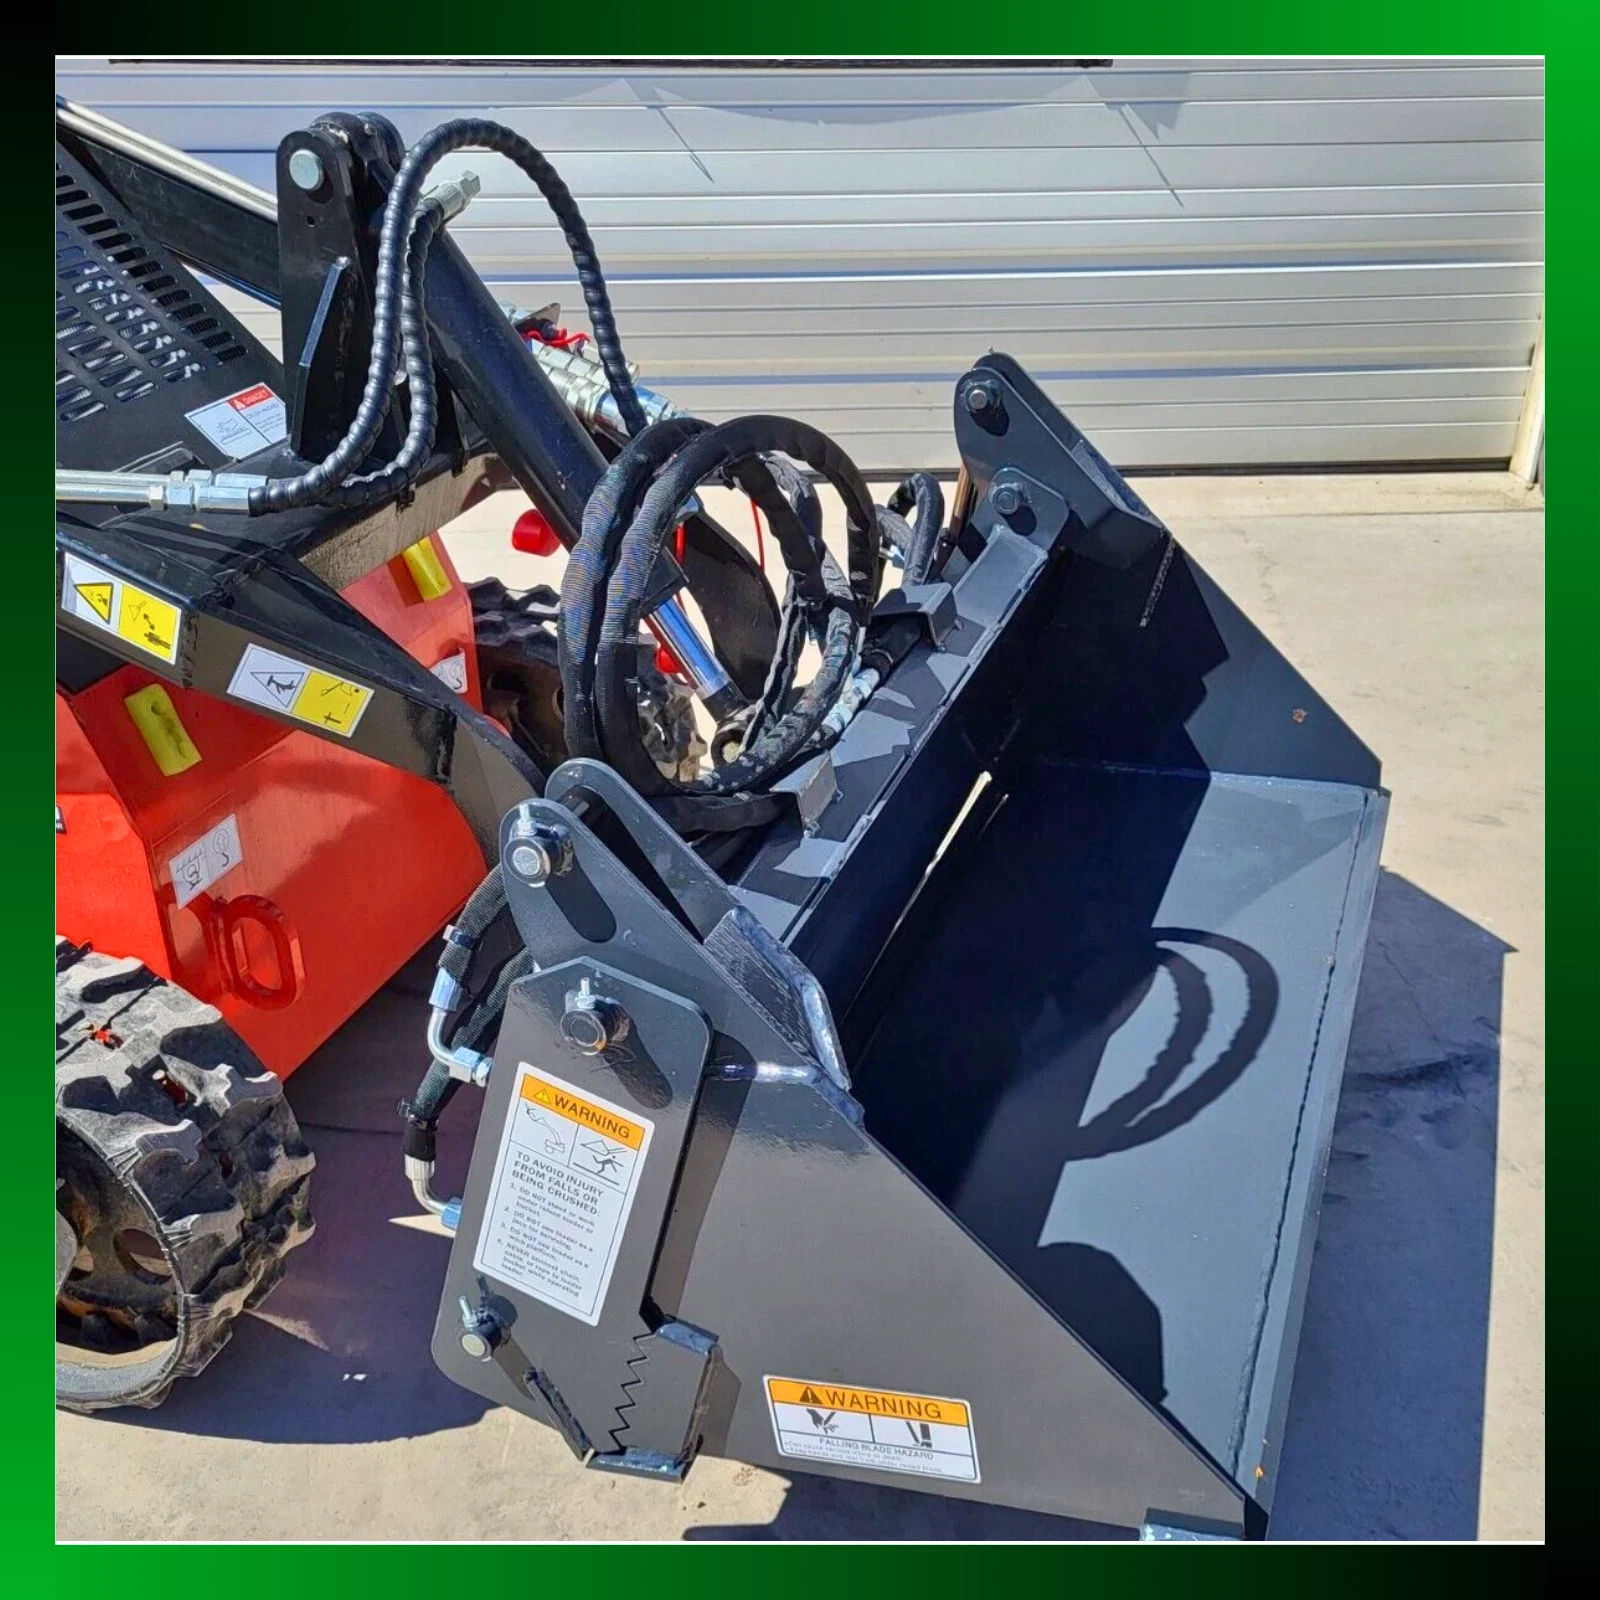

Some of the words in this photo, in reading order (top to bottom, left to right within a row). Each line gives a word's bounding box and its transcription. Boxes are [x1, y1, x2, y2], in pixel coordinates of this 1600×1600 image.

[554, 1094, 630, 1139] WARNING
[514, 1160, 546, 1180] FROM
[548, 1176, 579, 1197] FALLS
[582, 1191, 598, 1205] OR
[517, 1150, 530, 1162] TO
[532, 1158, 564, 1179] AVOID
[566, 1173, 604, 1197] INJURY
[511, 1169, 544, 1190] BEING
[547, 1187, 600, 1217] CRUSHED:
[519, 1186, 530, 1196] DO
[531, 1193, 546, 1203] NOT
[514, 1210, 525, 1219] DO
[526, 1216, 541, 1227] NOT
[507, 1243, 529, 1257] NEVER
[523, 1233, 537, 1243] NOT
[825, 1388, 941, 1419] WARNING
[820, 1438, 859, 1450] FALLING
[861, 1443, 892, 1455] BLADE
[894, 1448, 934, 1460] HAZARD
